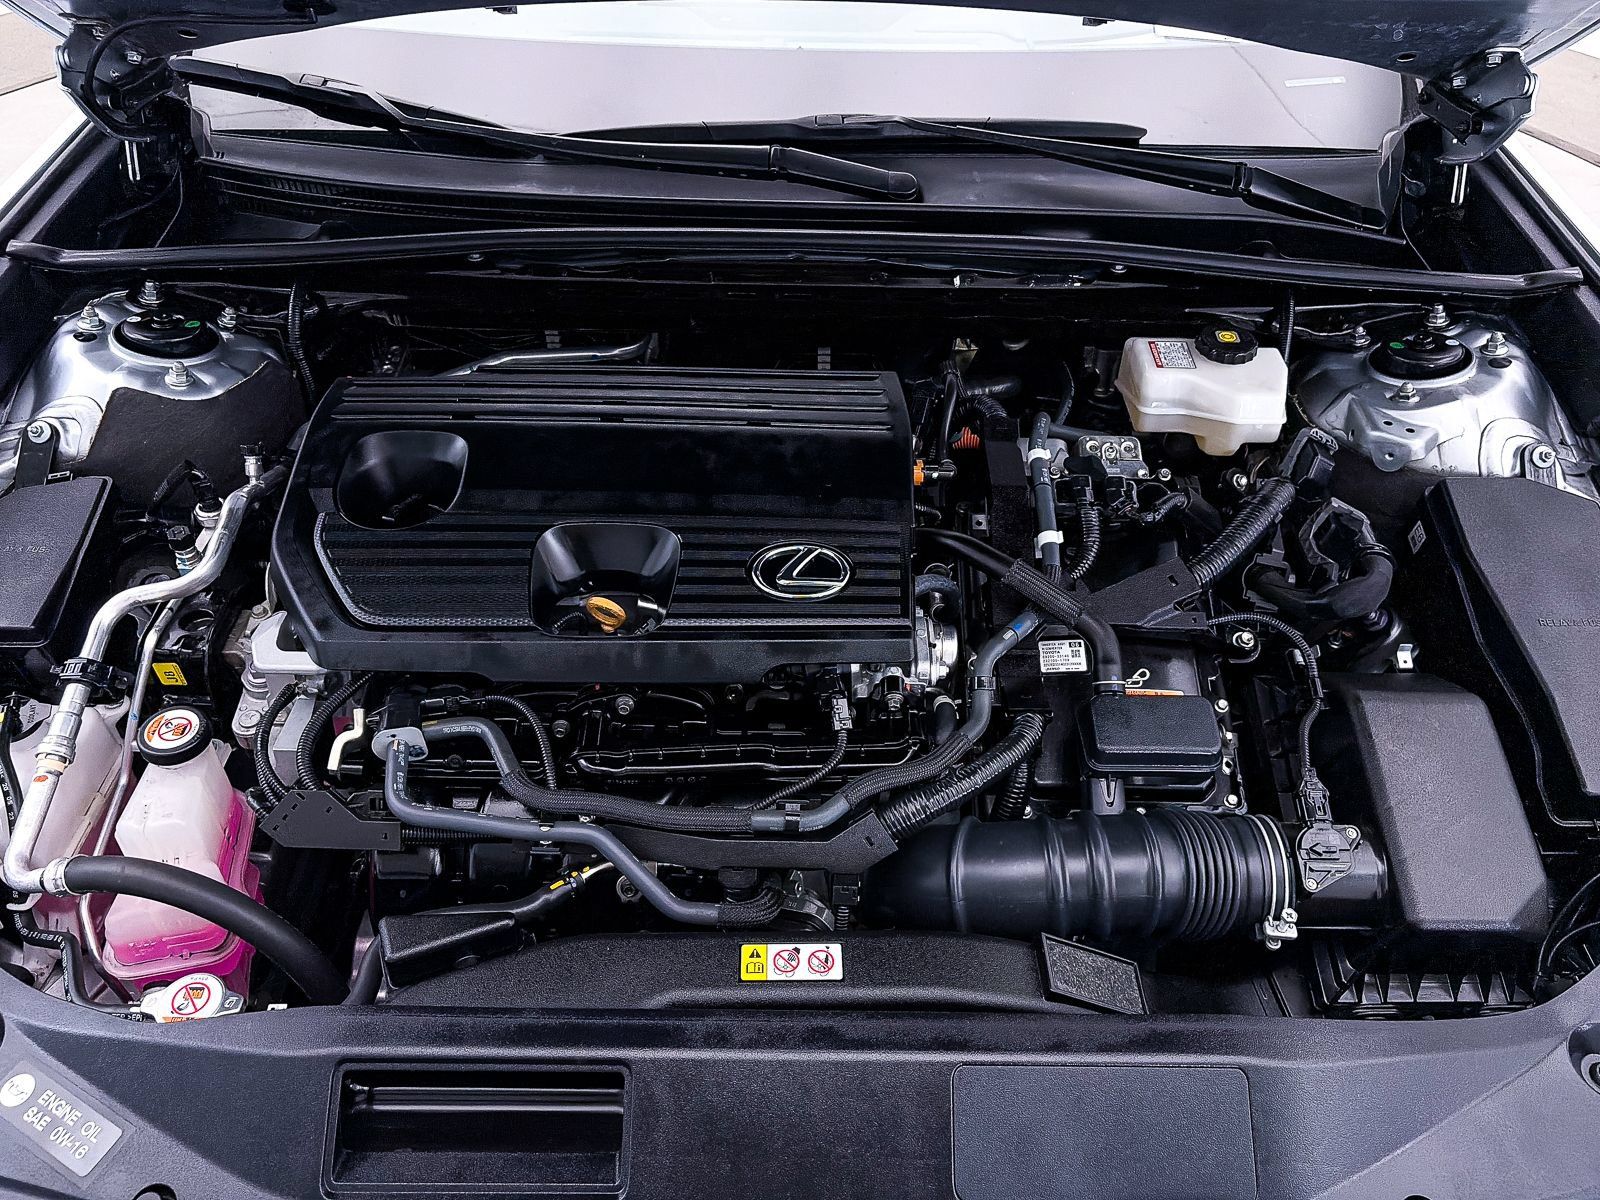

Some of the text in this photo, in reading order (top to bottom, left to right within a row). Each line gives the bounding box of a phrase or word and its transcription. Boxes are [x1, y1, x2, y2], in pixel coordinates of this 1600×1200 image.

[1537, 617, 1571, 627] RELAY
[22, 1107, 90, 1160] SAE 0W-16
[37, 1089, 102, 1144] ENGINE OIL
